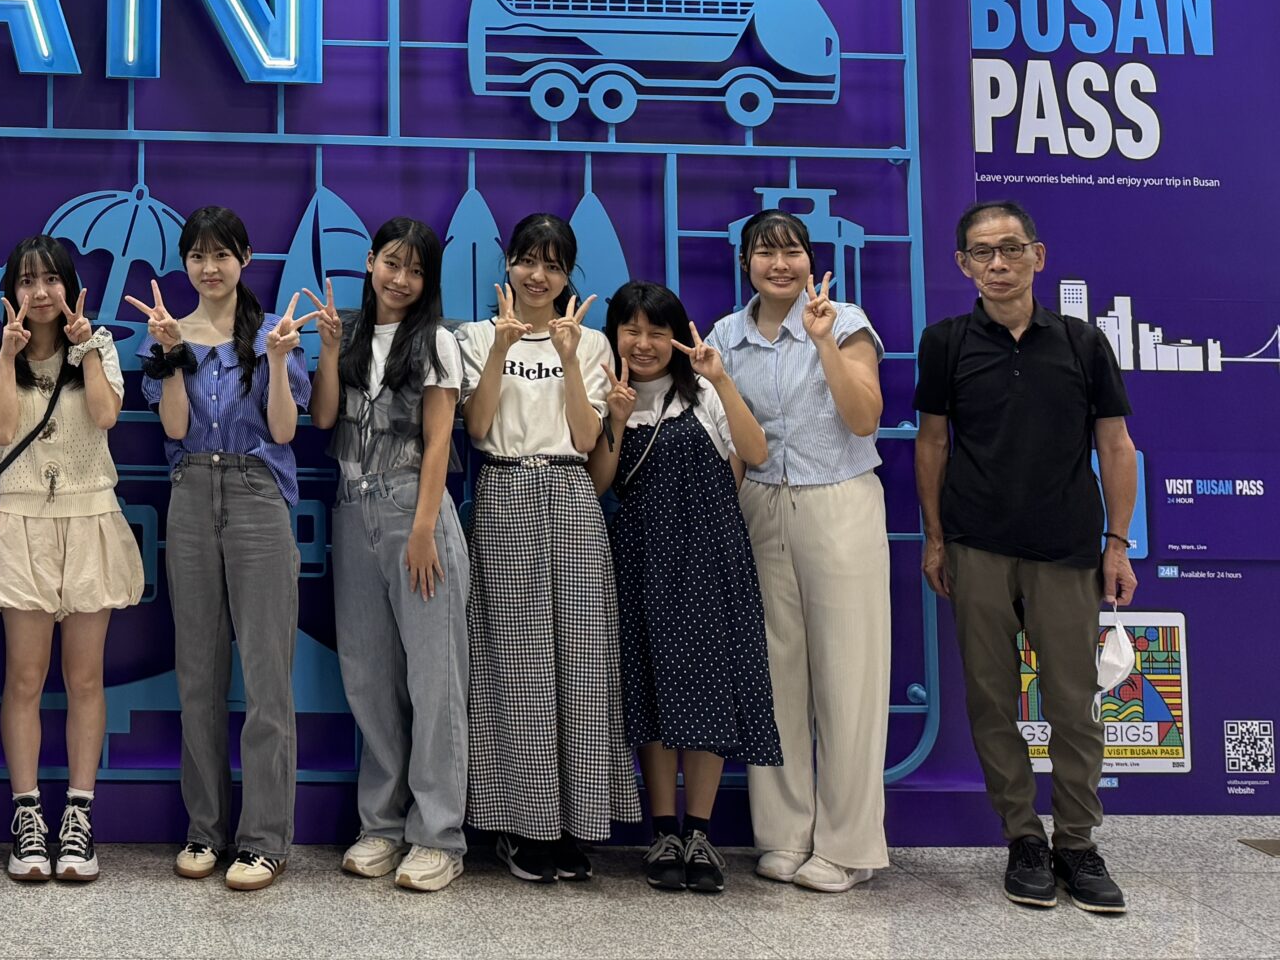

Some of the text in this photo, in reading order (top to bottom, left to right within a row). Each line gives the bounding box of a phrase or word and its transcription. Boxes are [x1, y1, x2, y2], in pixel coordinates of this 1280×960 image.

[972, 58, 1161, 160] PASS
[975, 172, 1221, 188] Leave your worries behind, and enjoy your trip in Busan
[1165, 479, 1265, 496] VISIT BUSAN PASS
[1160, 567, 1178, 577] 24H
[1180, 570, 1207, 579] Available
[1206, 571, 1216, 579] for
[1225, 572, 1243, 580] hours
[1106, 725, 1153, 743] BIG5
[1107, 748, 1180, 756] VISIT BUSAN PASS
[1226, 786, 1255, 795] Website
